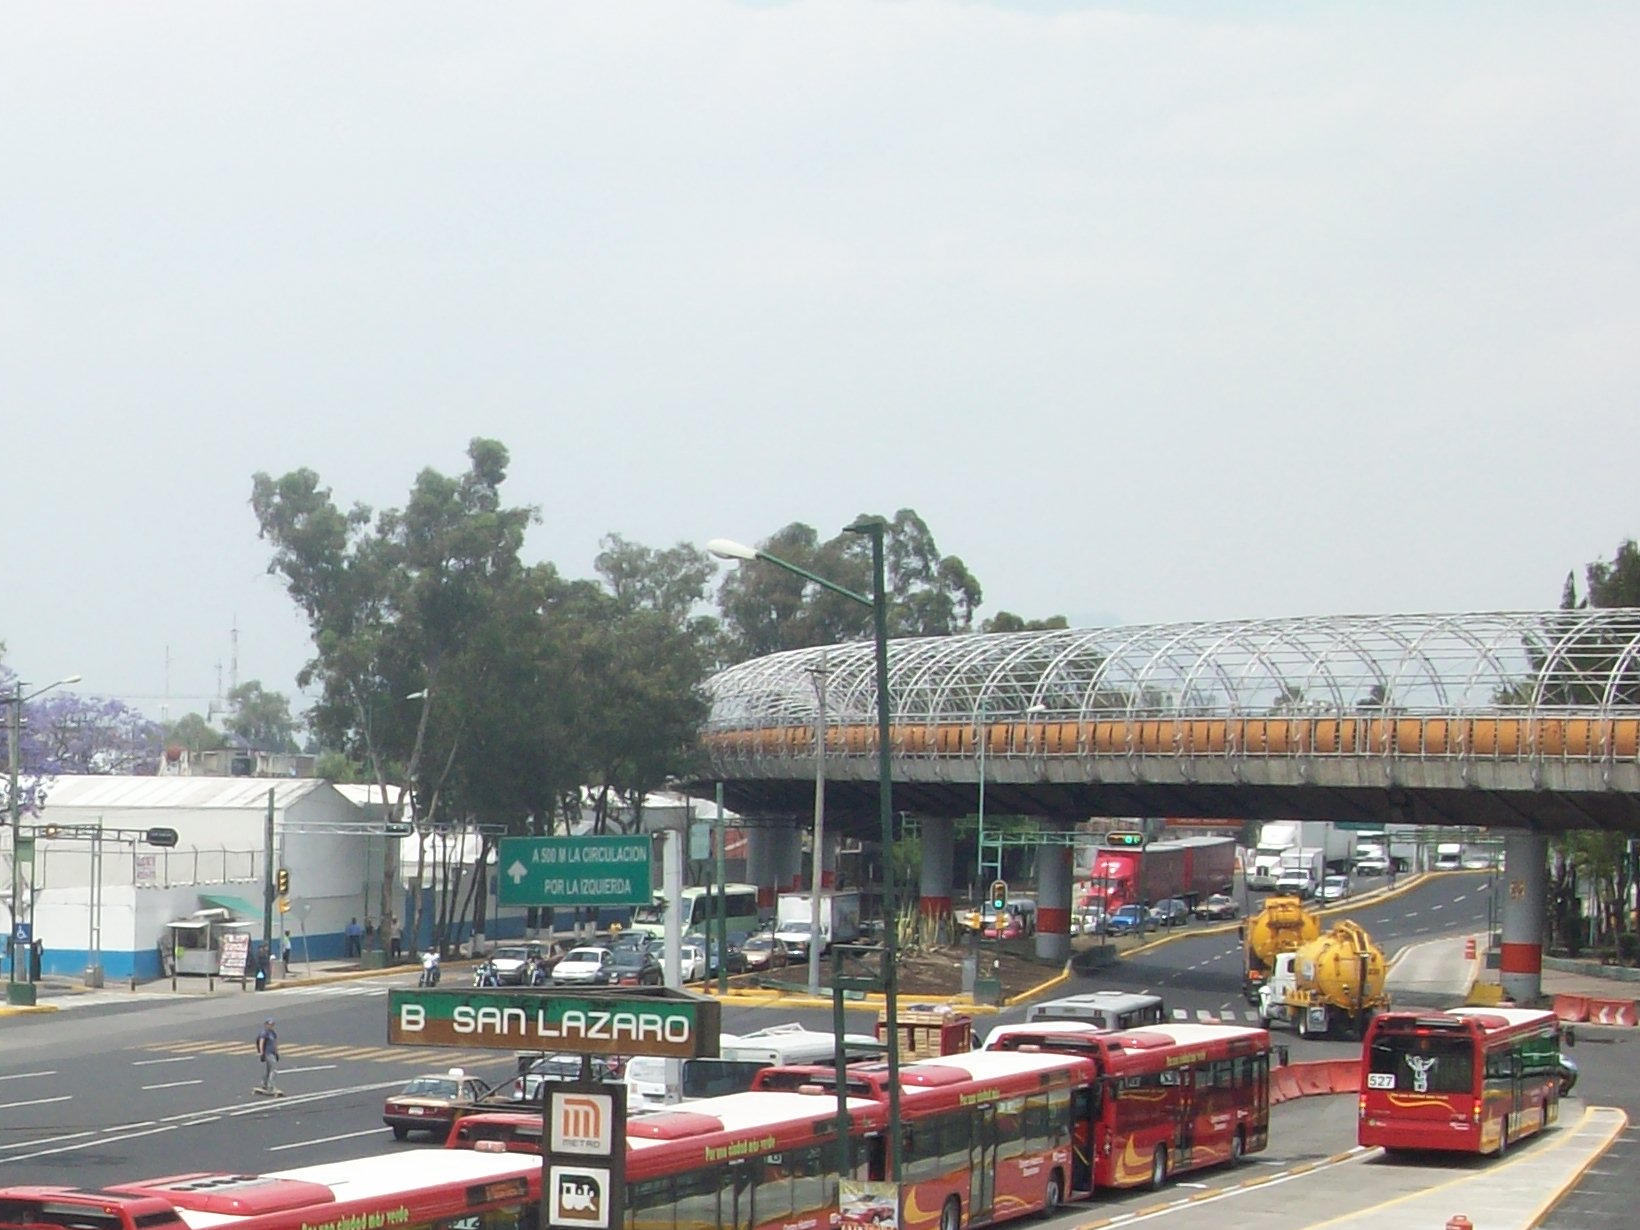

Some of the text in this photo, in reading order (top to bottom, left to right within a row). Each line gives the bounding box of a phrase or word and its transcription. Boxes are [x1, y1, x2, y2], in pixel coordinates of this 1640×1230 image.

[532, 848, 540, 863] A
[568, 847, 581, 863] LA
[582, 847, 647, 862] CIRCULACION
[544, 878, 632, 895] POR LA IZQUIERDA
[400, 1004, 689, 1043] B SAN LAZARO
[1369, 1075, 1393, 1087] 527
[562, 1139, 600, 1149] METRO
